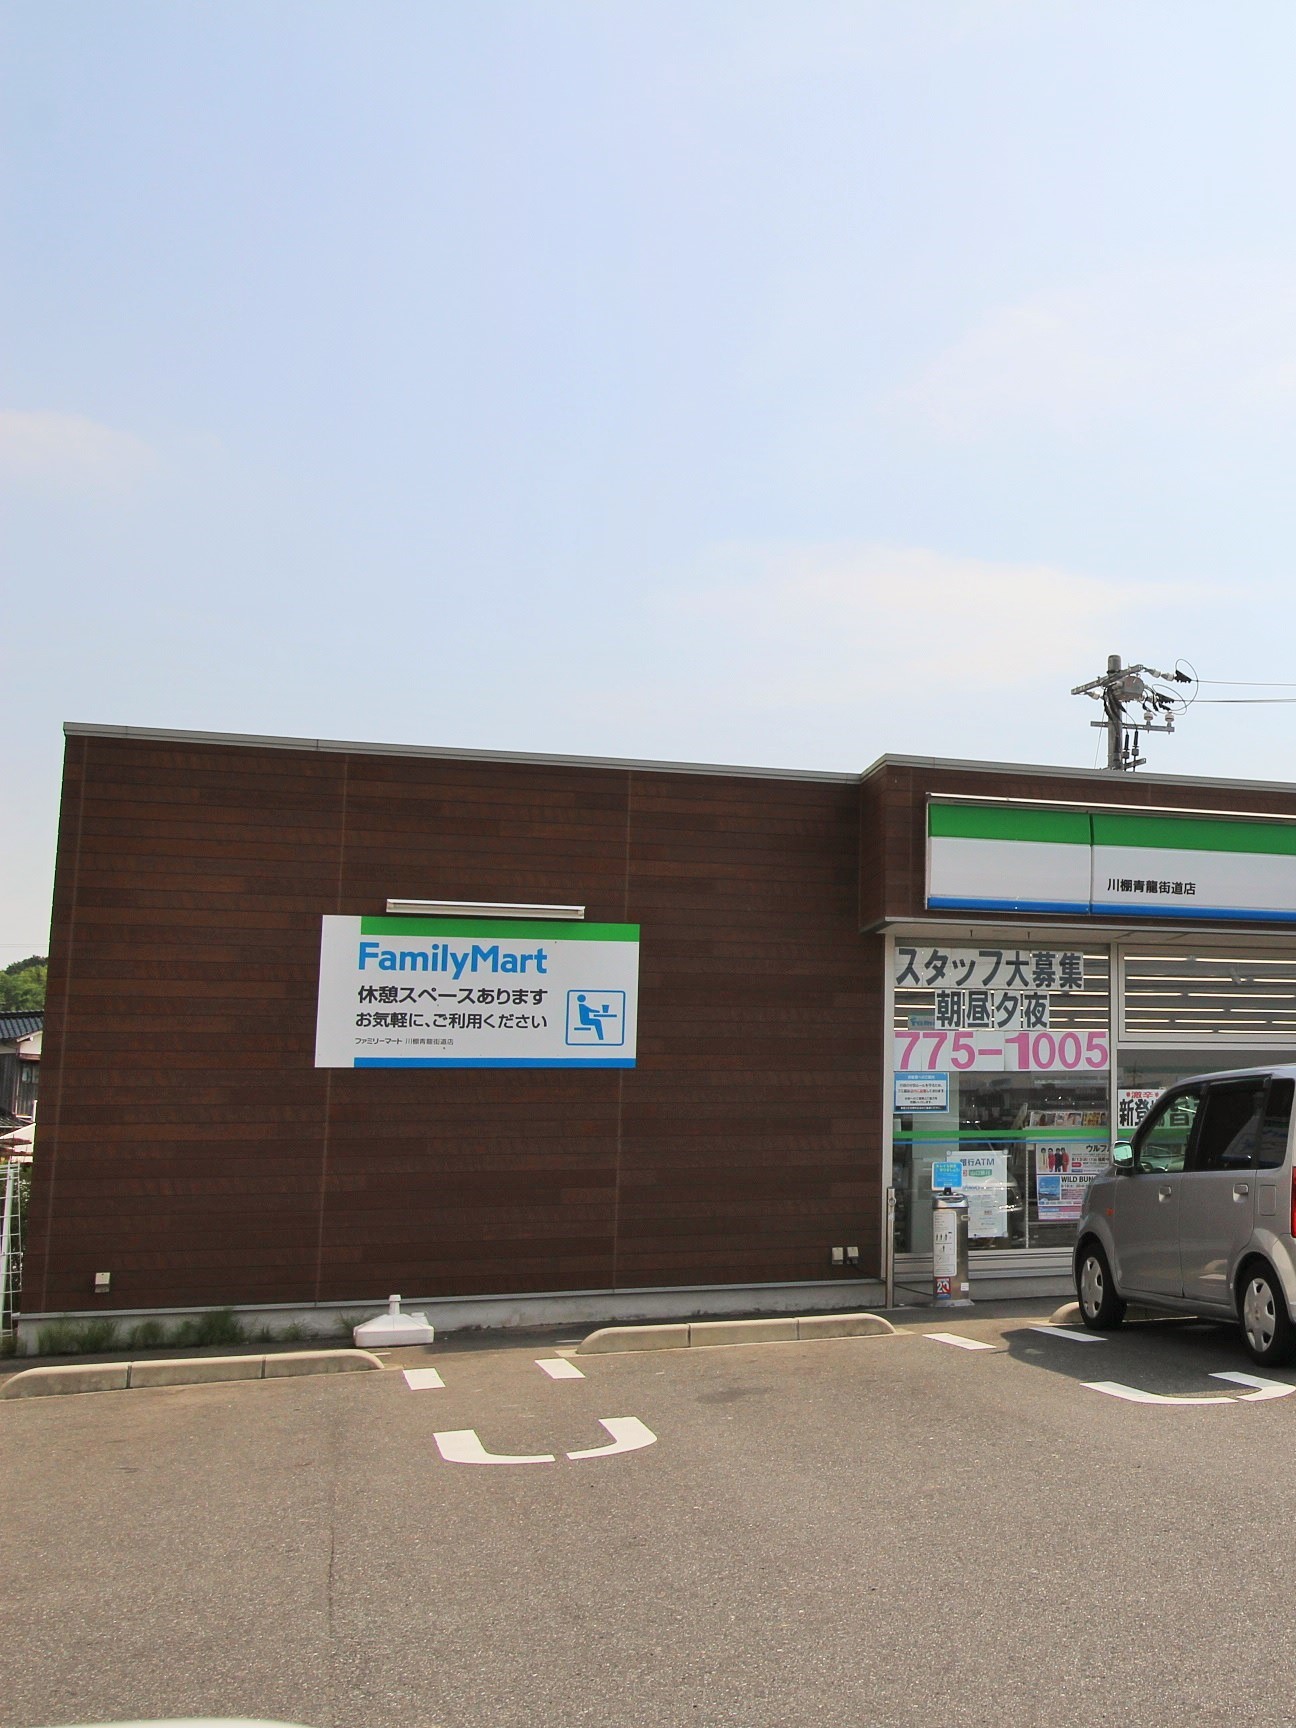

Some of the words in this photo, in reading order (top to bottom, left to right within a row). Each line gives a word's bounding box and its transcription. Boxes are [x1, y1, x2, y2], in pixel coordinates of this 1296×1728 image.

[1107, 878, 1196, 895] 川棚青龍街道店
[357, 941, 548, 980] FamilyMart
[896, 948, 1083, 989] スタッフ大募集
[357, 985, 548, 1006] 休憩スペースあります
[355, 1012, 548, 1029] お気軽に、ご利用ください
[936, 990, 1049, 1029] 朝昼夕夜
[354, 1037, 403, 1045] ファミリーマート
[1119, 1098, 1164, 1127] 新登
